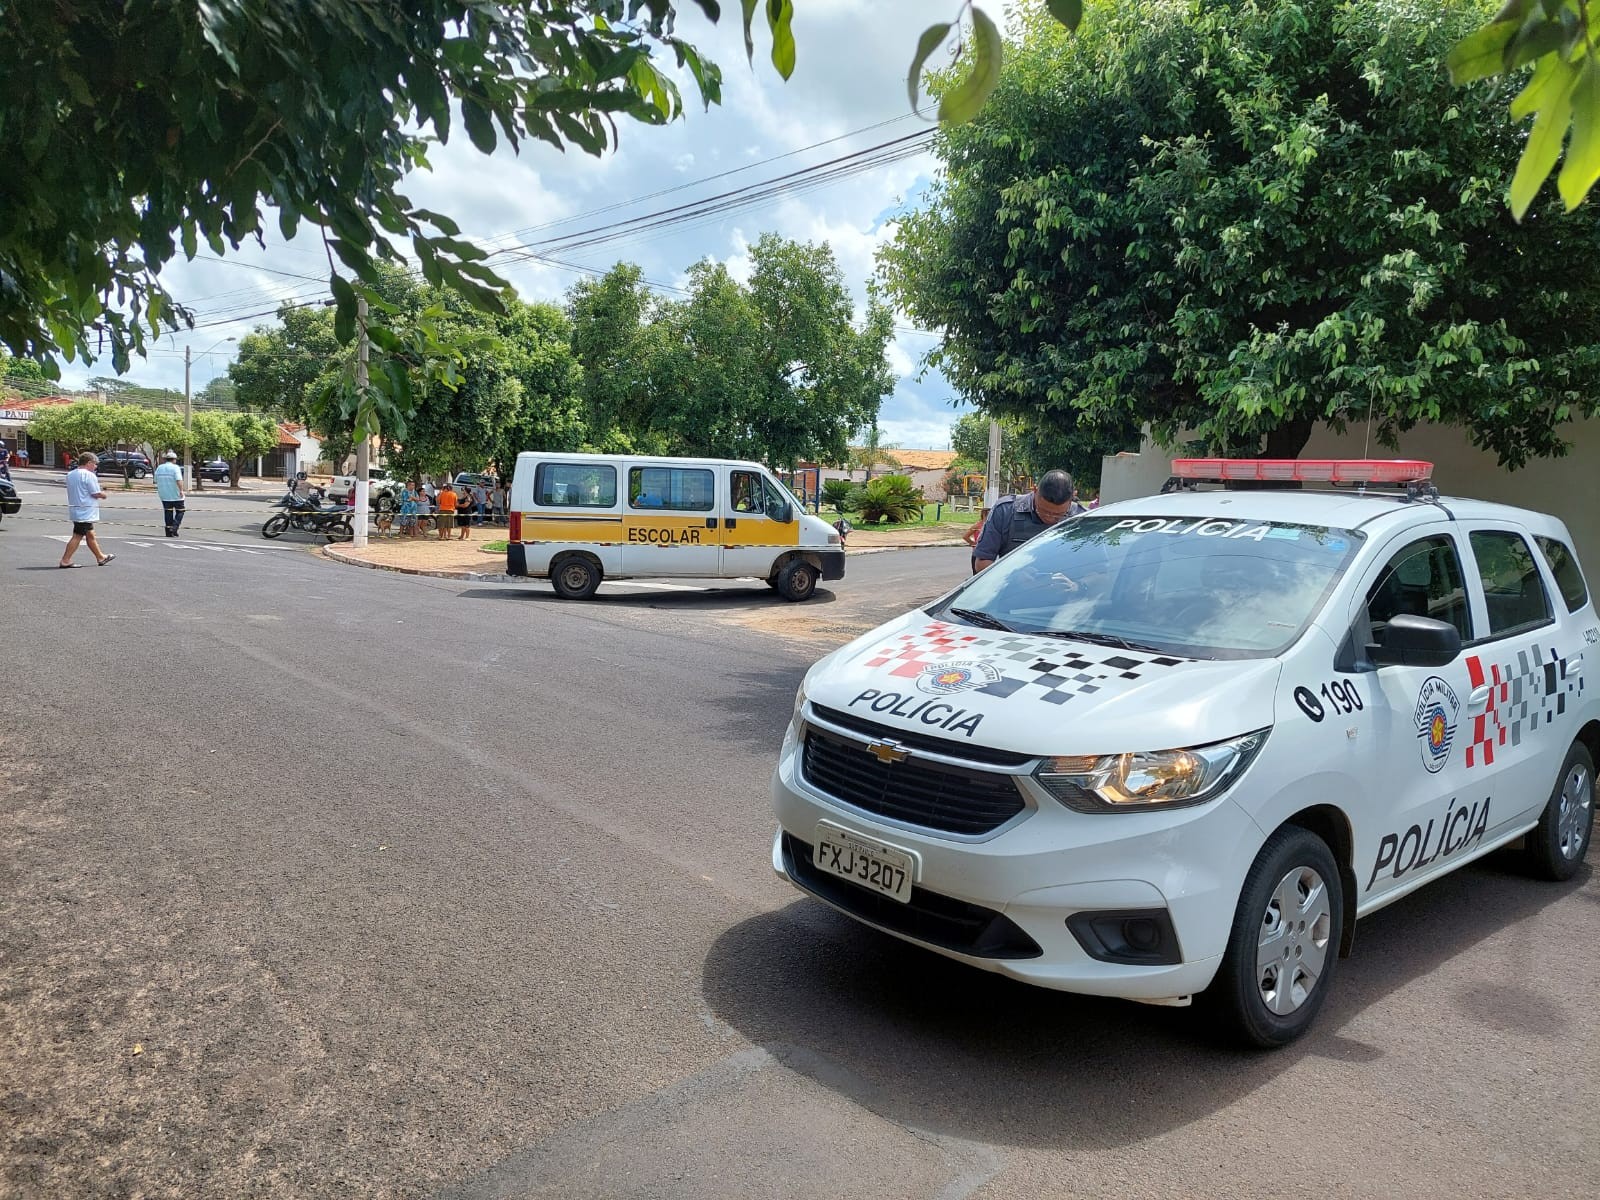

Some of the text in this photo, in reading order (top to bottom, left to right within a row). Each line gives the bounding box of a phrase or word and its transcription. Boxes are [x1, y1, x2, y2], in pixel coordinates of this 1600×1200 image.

[628, 527, 701, 544] ESCOLAR
[1104, 517, 1270, 542] POLÍCIA
[848, 688, 985, 737] POLÍCIA
[1320, 678, 1364, 715] 190
[1435, 681, 1458, 713] MILITAR
[1365, 796, 1491, 892] POLÍCIA
